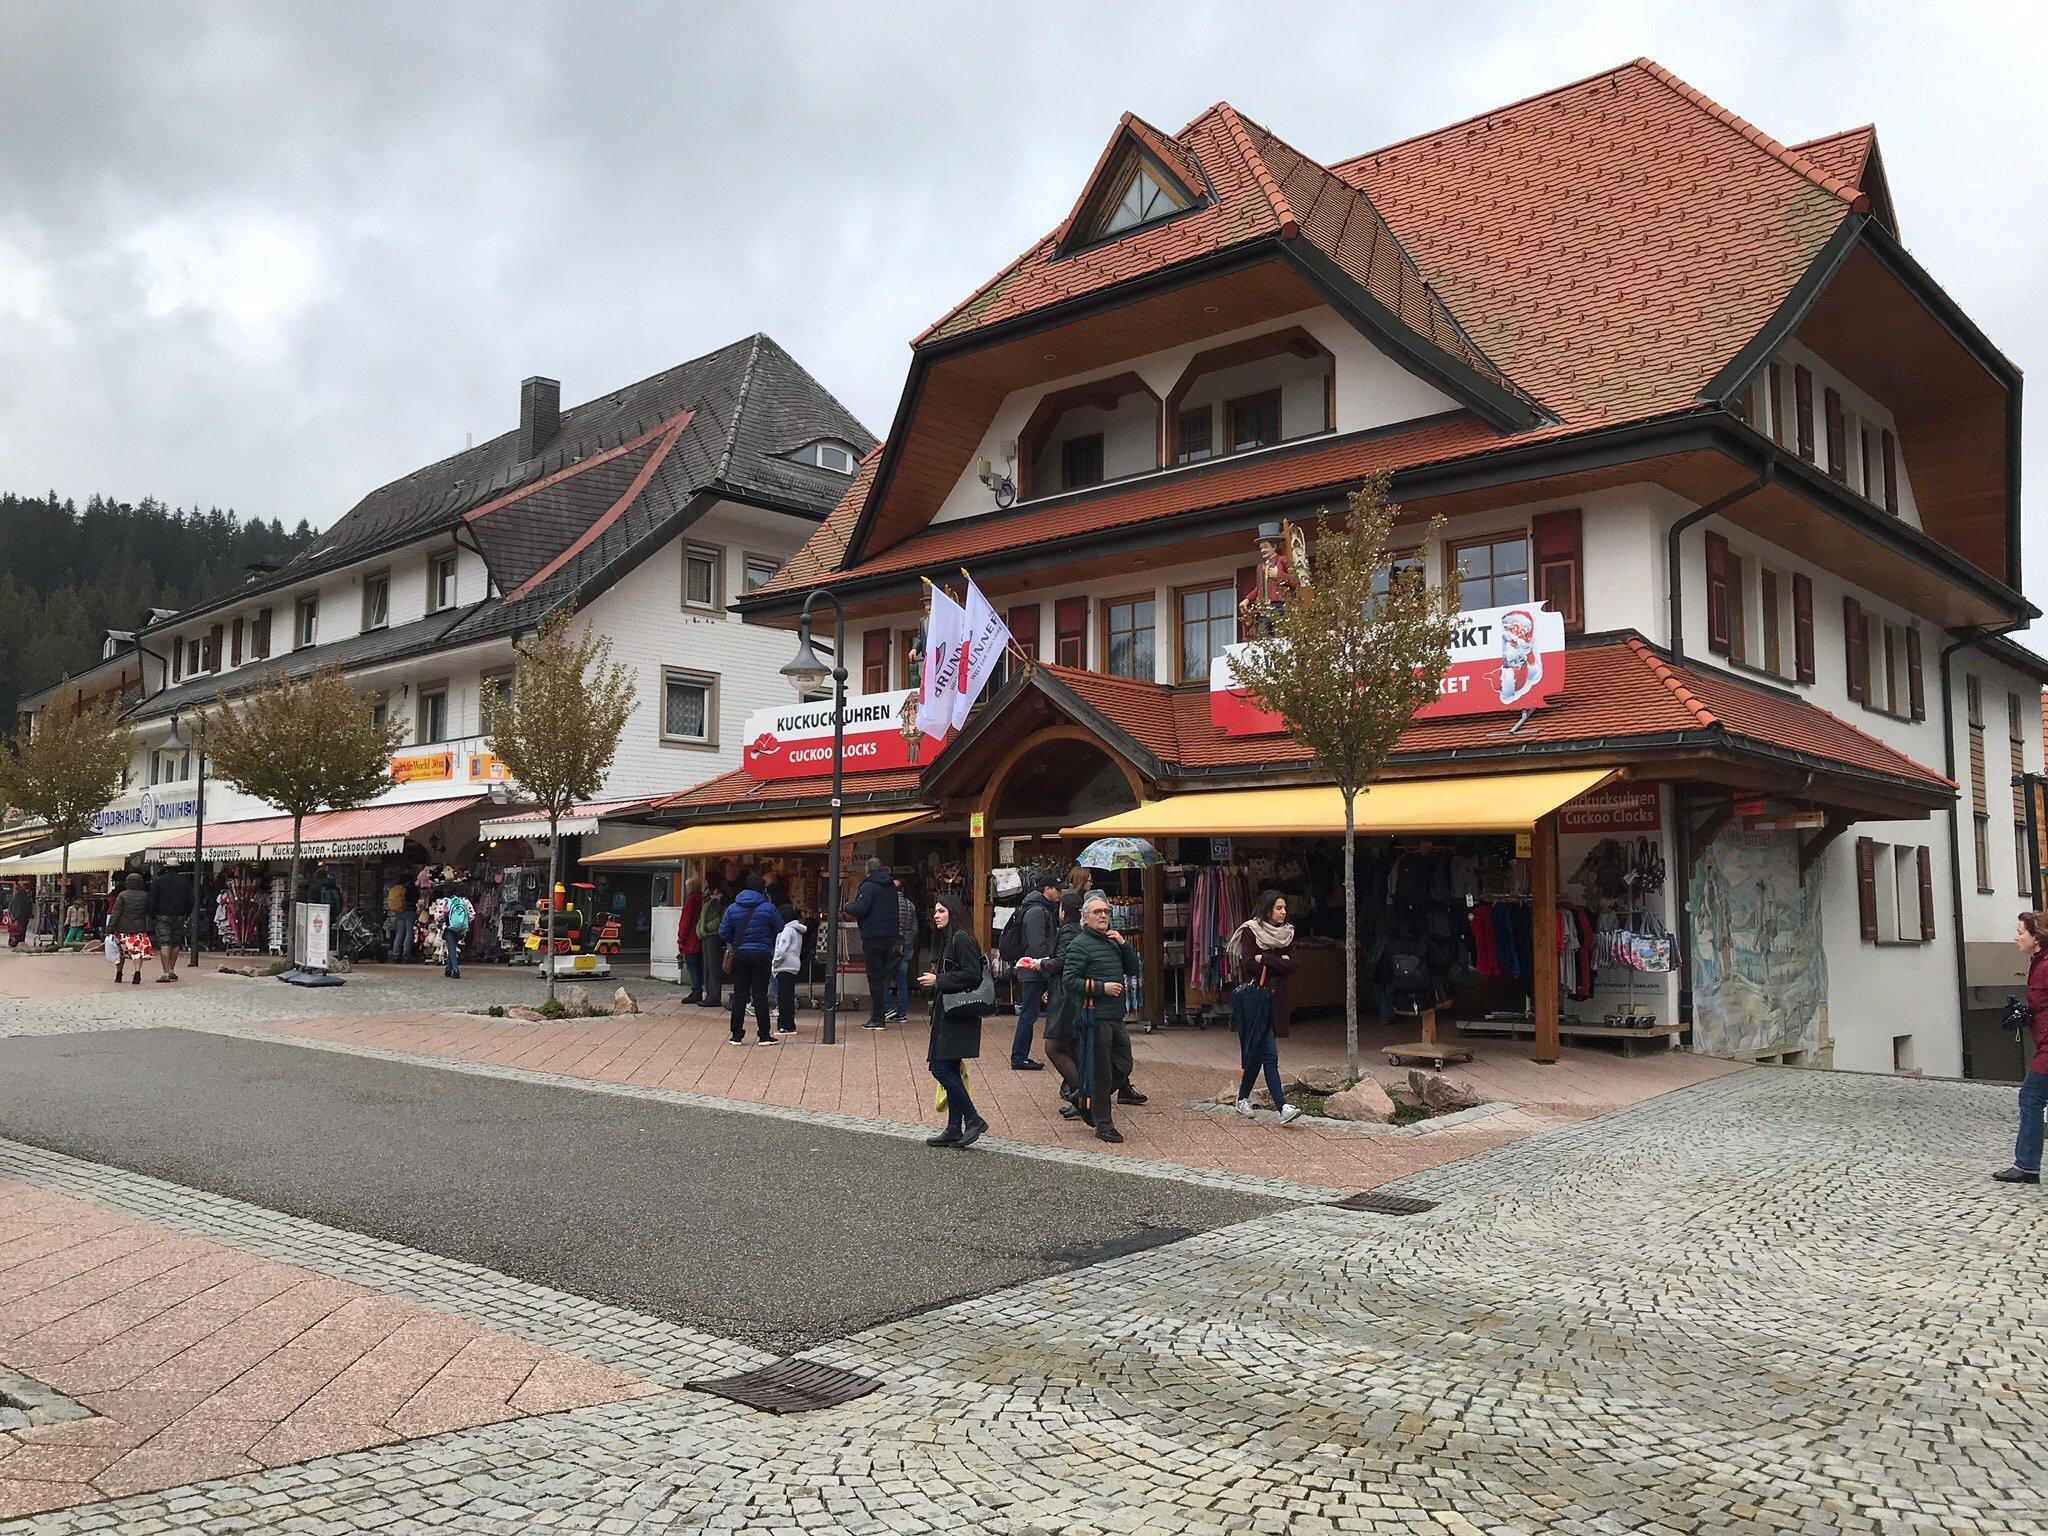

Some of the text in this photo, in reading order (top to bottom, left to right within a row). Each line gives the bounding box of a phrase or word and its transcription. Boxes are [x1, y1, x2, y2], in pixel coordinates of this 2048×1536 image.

[776, 704, 891, 732] KUCKUCKUHREN
[788, 746, 833, 763] CUCKOO
[841, 742, 877, 758] LOCKS
[1566, 790, 1656, 809] uckucksuhren
[1565, 807, 1654, 825] Cuckoo Clocks
[209, 847, 241, 858] Souvenirs
[272, 844, 325, 857] Kuckukuhren
[332, 839, 388, 854] Cuckooclocks
